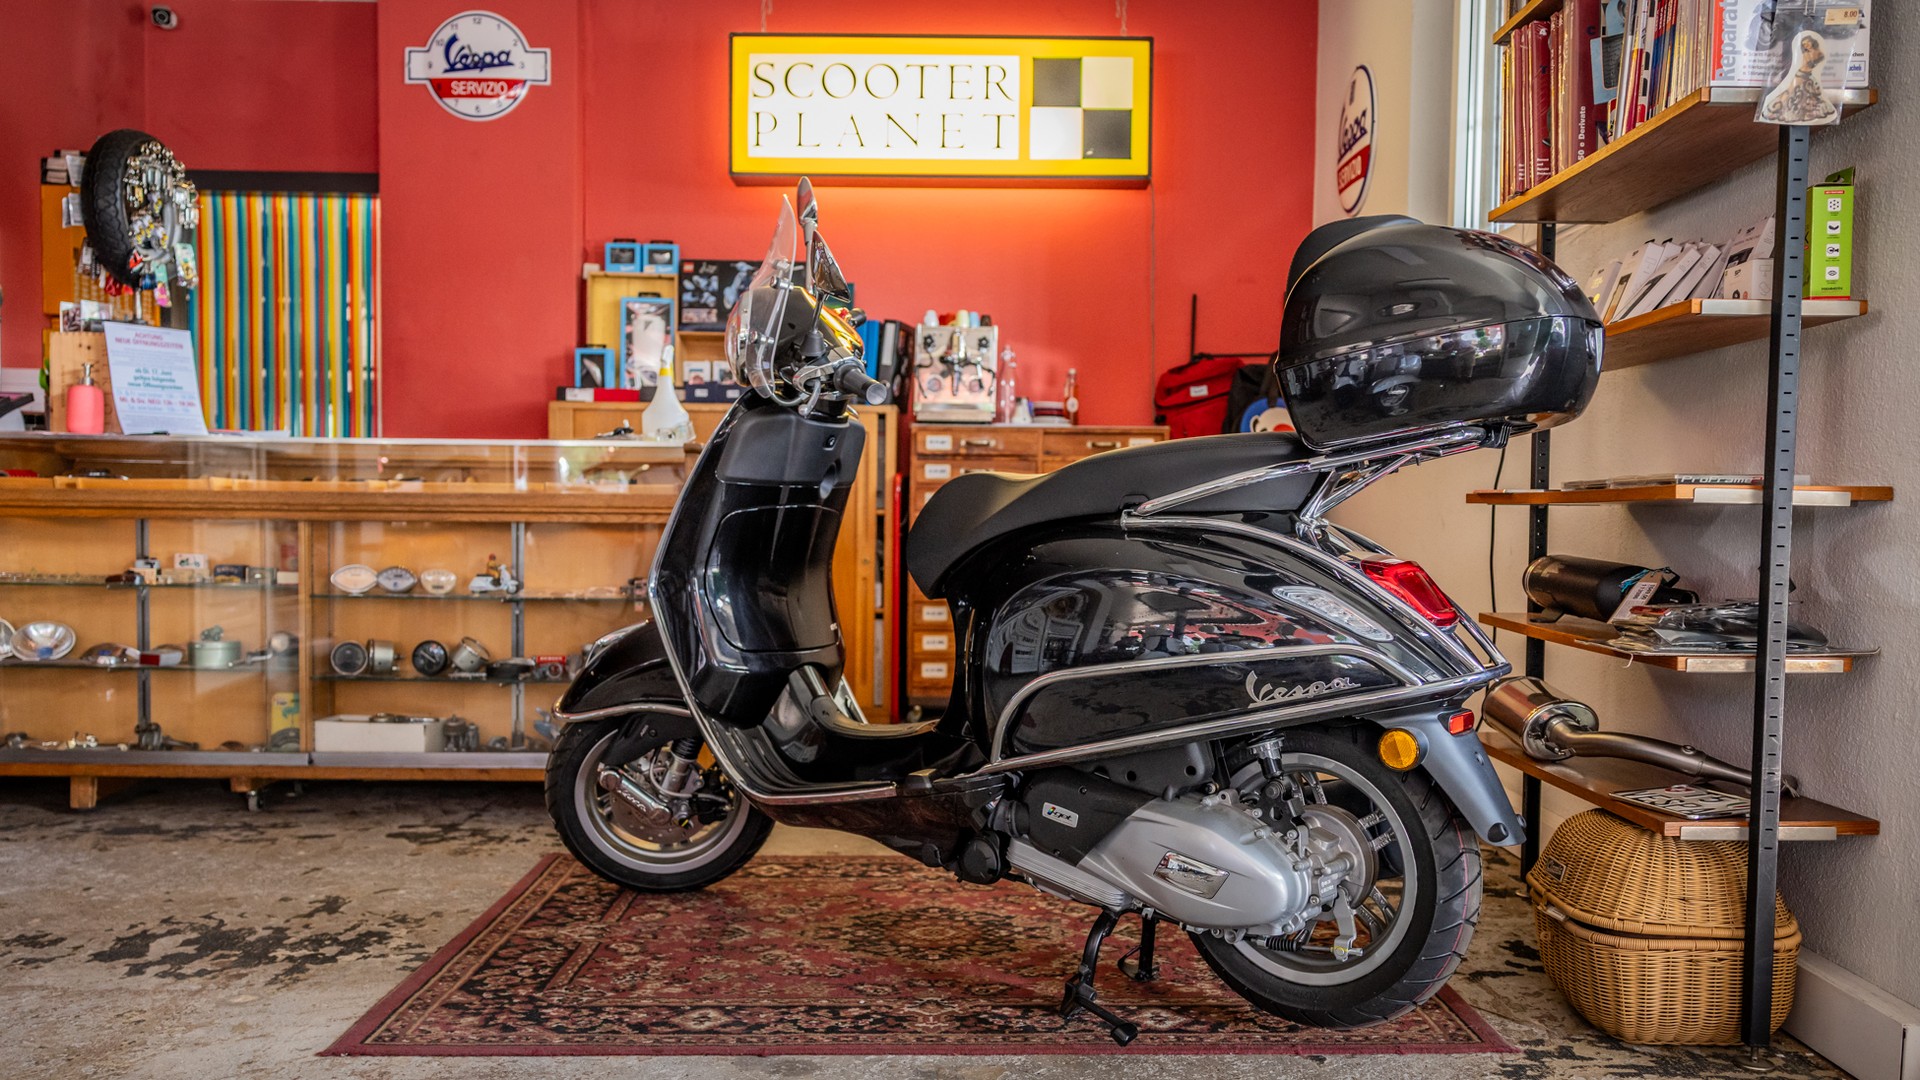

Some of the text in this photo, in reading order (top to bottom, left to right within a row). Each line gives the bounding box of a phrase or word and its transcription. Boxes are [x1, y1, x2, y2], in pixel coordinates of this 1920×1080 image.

[442, 33, 515, 73] Vespa
[451, 81, 508, 96] SERVIZIO
[752, 61, 1016, 102] SCOOTER
[752, 110, 1016, 150] PLANET
[1578, 106, 1586, 139] Derivate
[1245, 670, 1361, 708] Vespa
